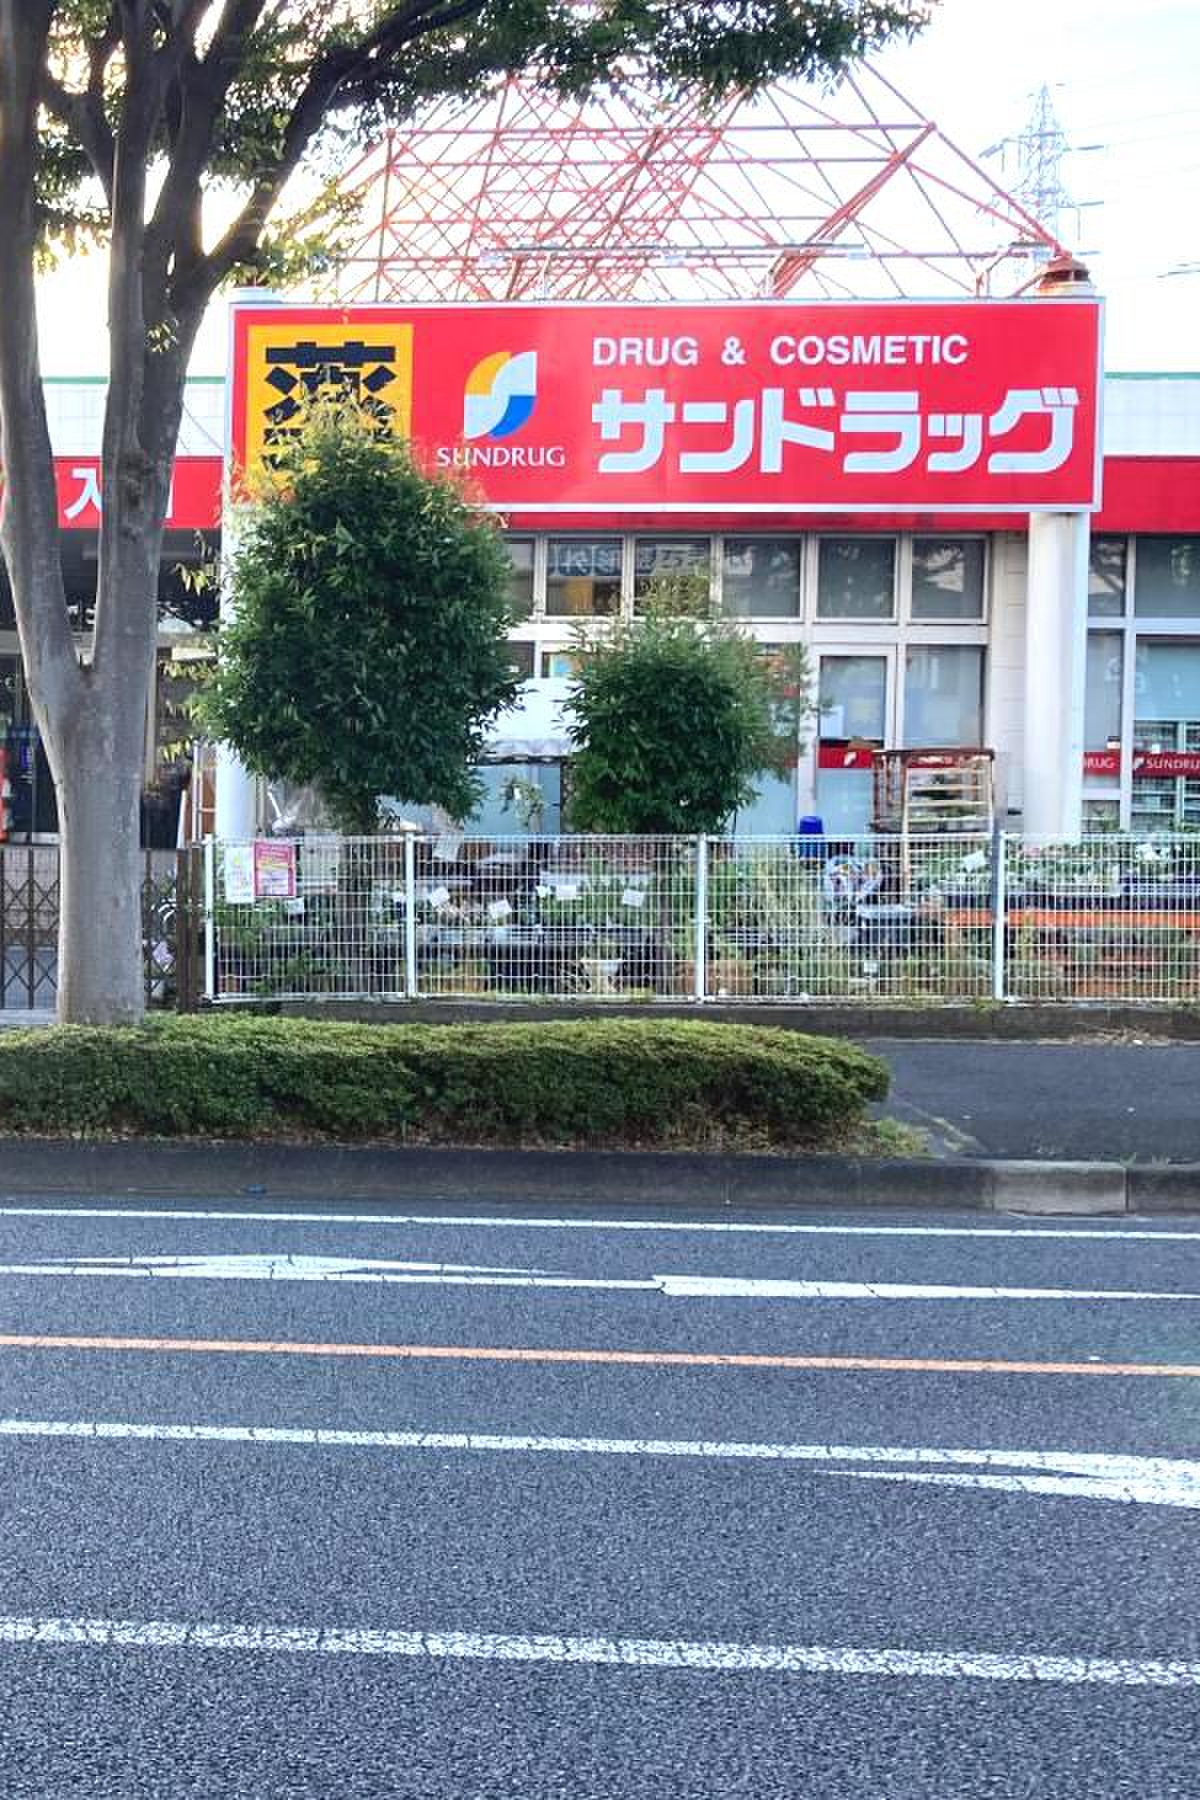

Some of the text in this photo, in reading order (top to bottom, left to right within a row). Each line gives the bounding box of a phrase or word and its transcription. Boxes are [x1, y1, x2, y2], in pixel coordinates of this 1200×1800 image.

[592, 335, 969, 366] DRUG & COSMETIC
[591, 387, 1080, 474] サンドラッグ
[436, 447, 566, 467] SUNDRUG
